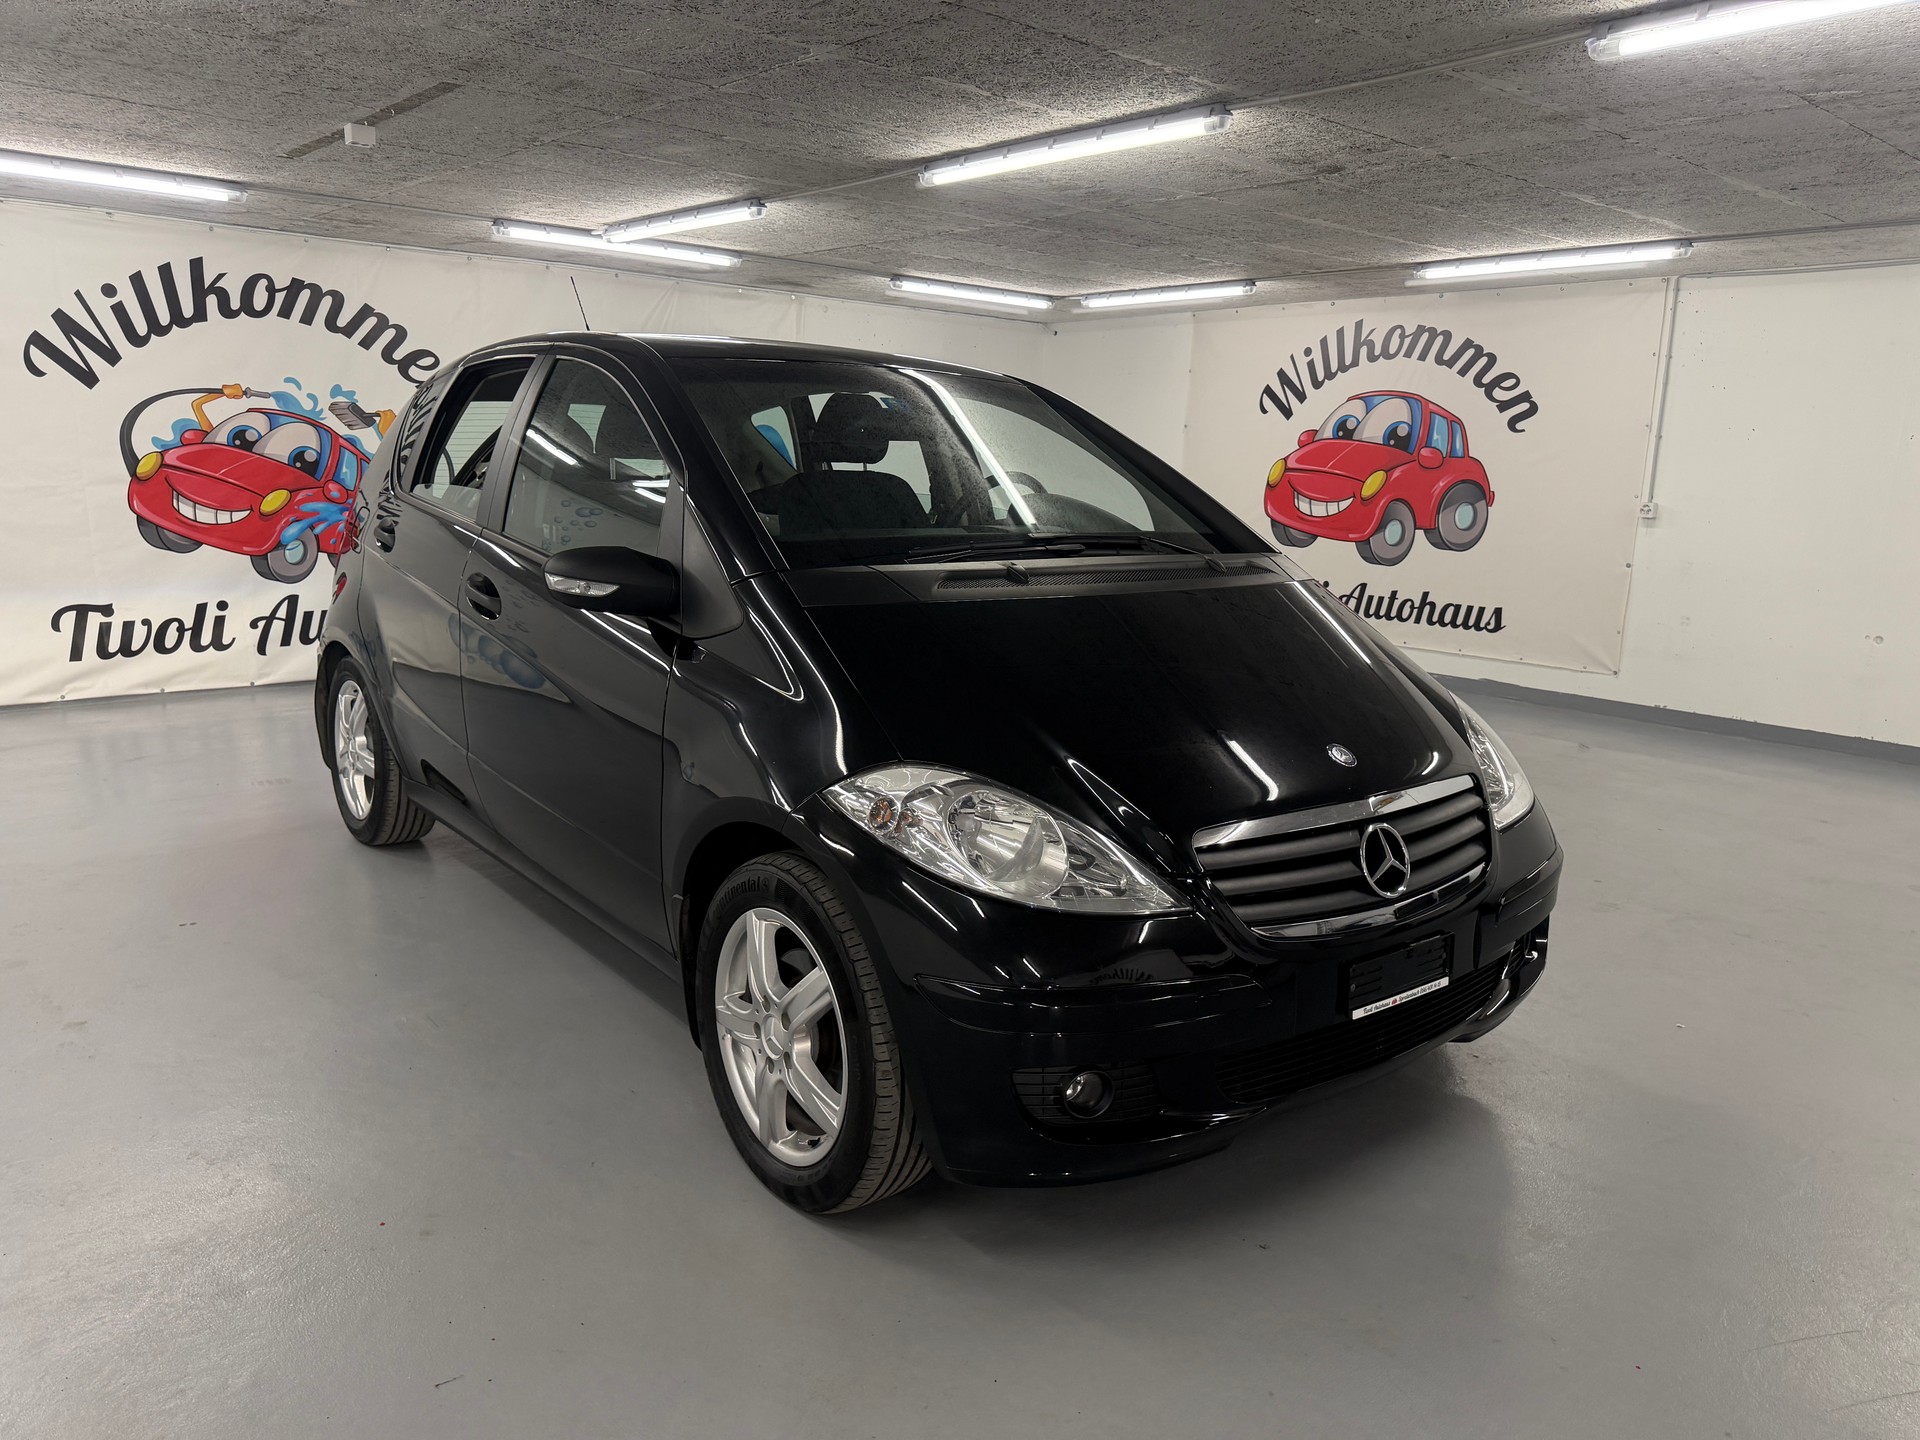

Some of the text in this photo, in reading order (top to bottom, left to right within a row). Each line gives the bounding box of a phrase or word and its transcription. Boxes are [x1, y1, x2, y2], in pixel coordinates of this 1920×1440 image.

[22, 256, 441, 390] Willkomme
[1259, 318, 1540, 434] Willkommen
[50, 593, 329, 663] Tivoli Au
[1338, 582, 1507, 634] Autohaus
